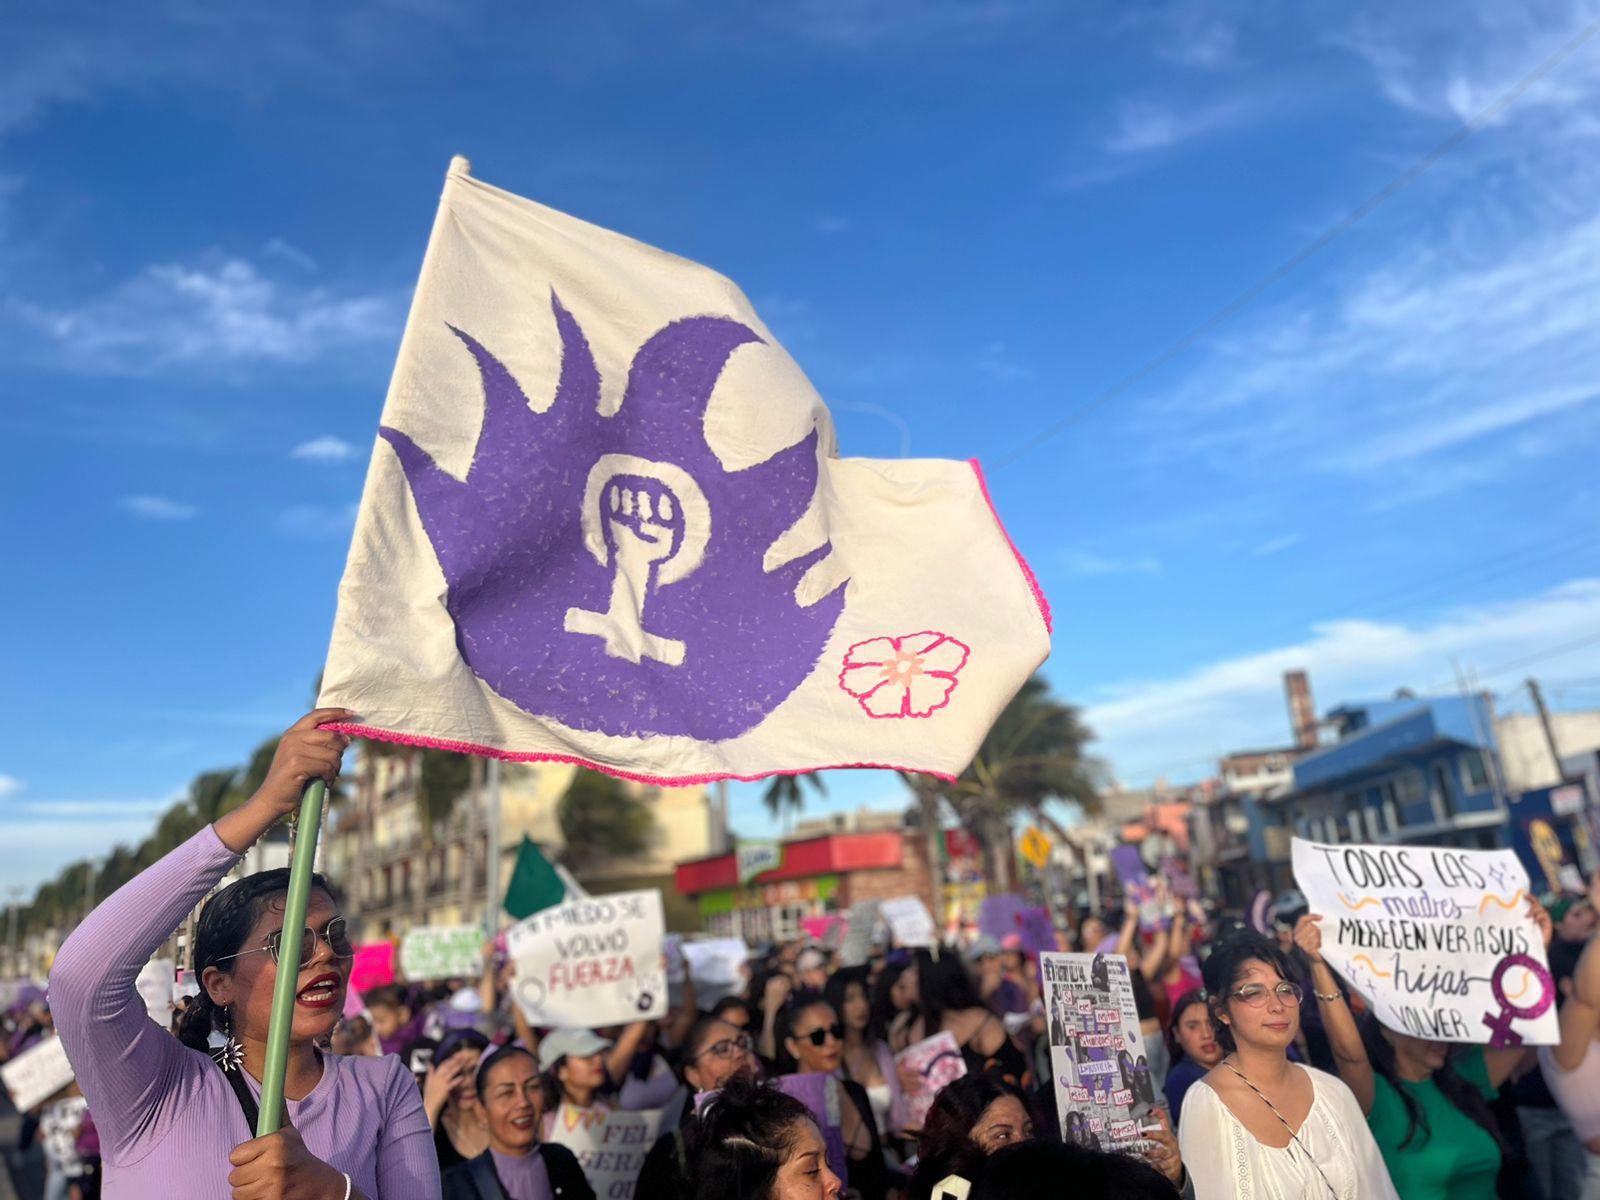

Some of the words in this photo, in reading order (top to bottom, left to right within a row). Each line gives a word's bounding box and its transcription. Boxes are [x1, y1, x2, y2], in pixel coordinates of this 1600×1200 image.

[1312, 845, 1423, 889] TODAS
[1431, 851, 1486, 889] LAS
[1380, 890, 1464, 919] madres
[1338, 917, 1426, 951] MERECEN
[1435, 926, 1470, 954] VER
[1474, 928, 1486, 953] A
[1489, 926, 1530, 956] SUS
[548, 954, 635, 993] FUERZA
[1390, 951, 1472, 1008] hijas
[1389, 1004, 1471, 1038] VOLVER
